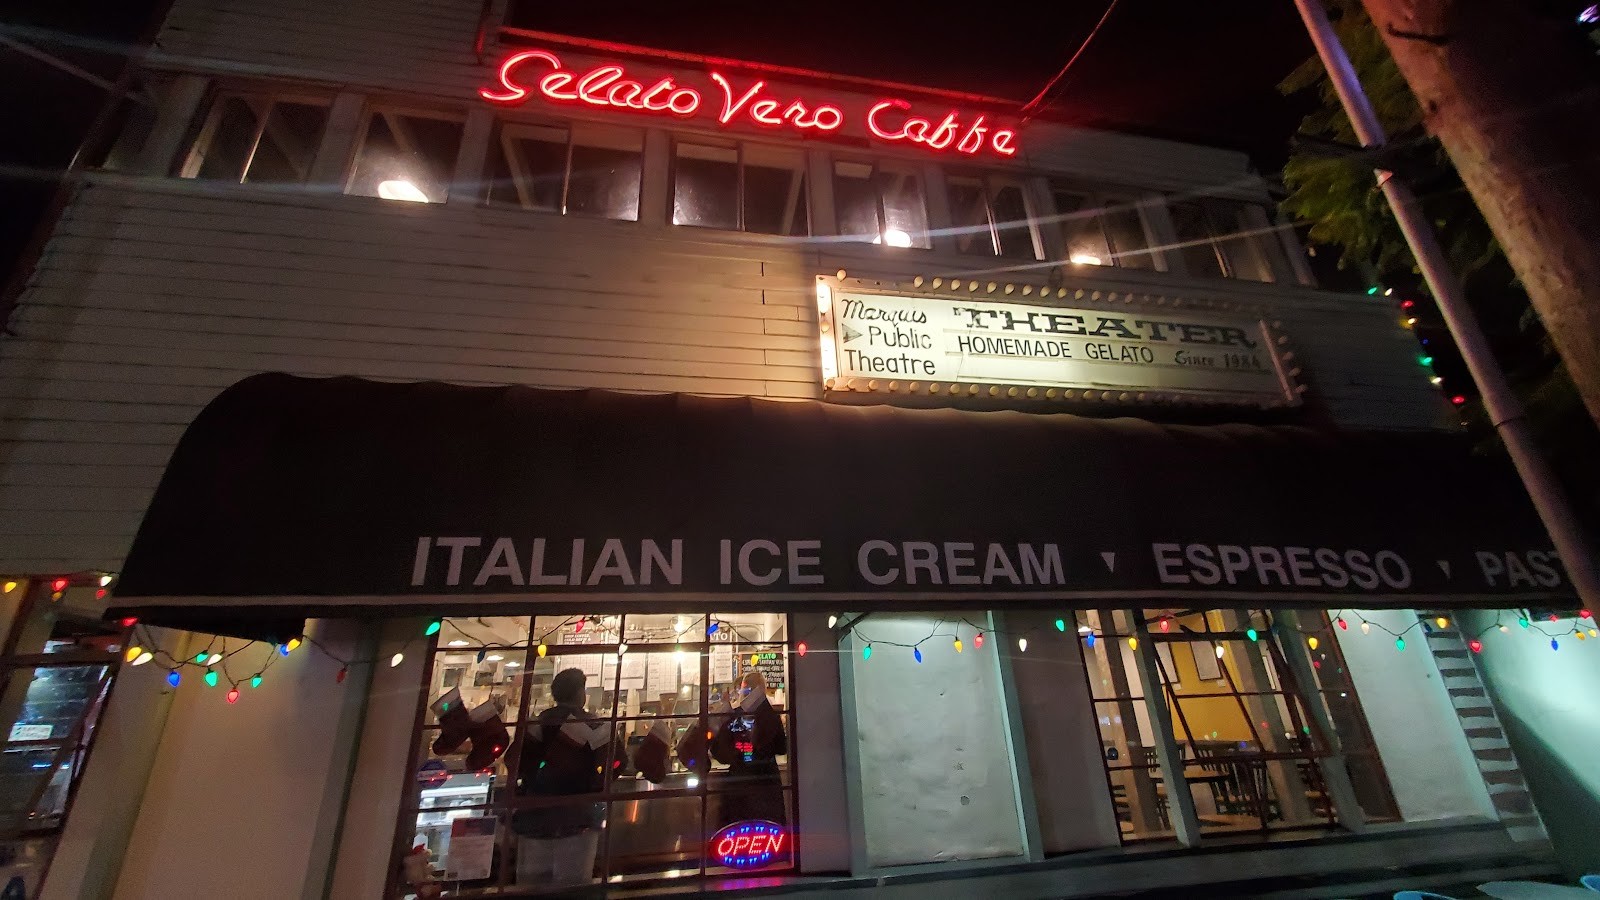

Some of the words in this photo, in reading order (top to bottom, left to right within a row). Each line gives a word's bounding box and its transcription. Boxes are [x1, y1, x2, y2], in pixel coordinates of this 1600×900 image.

[480, 50, 701, 113] Gelato
[710, 71, 843, 127] Vero
[866, 100, 1018, 155] Caffe
[841, 298, 927, 327] Marquis
[868, 325, 932, 349] Public
[952, 306, 1257, 349] THEATER
[844, 349, 936, 375] Theatre
[957, 335, 1073, 359] HOMEMADE
[1085, 342, 1154, 364] GELATO
[410, 536, 683, 587] ITALIAN
[719, 539, 825, 586] ICE
[857, 540, 1066, 586] CREAM
[1151, 543, 1413, 590] ESPRESSO
[717, 834, 784, 857] OPEN
